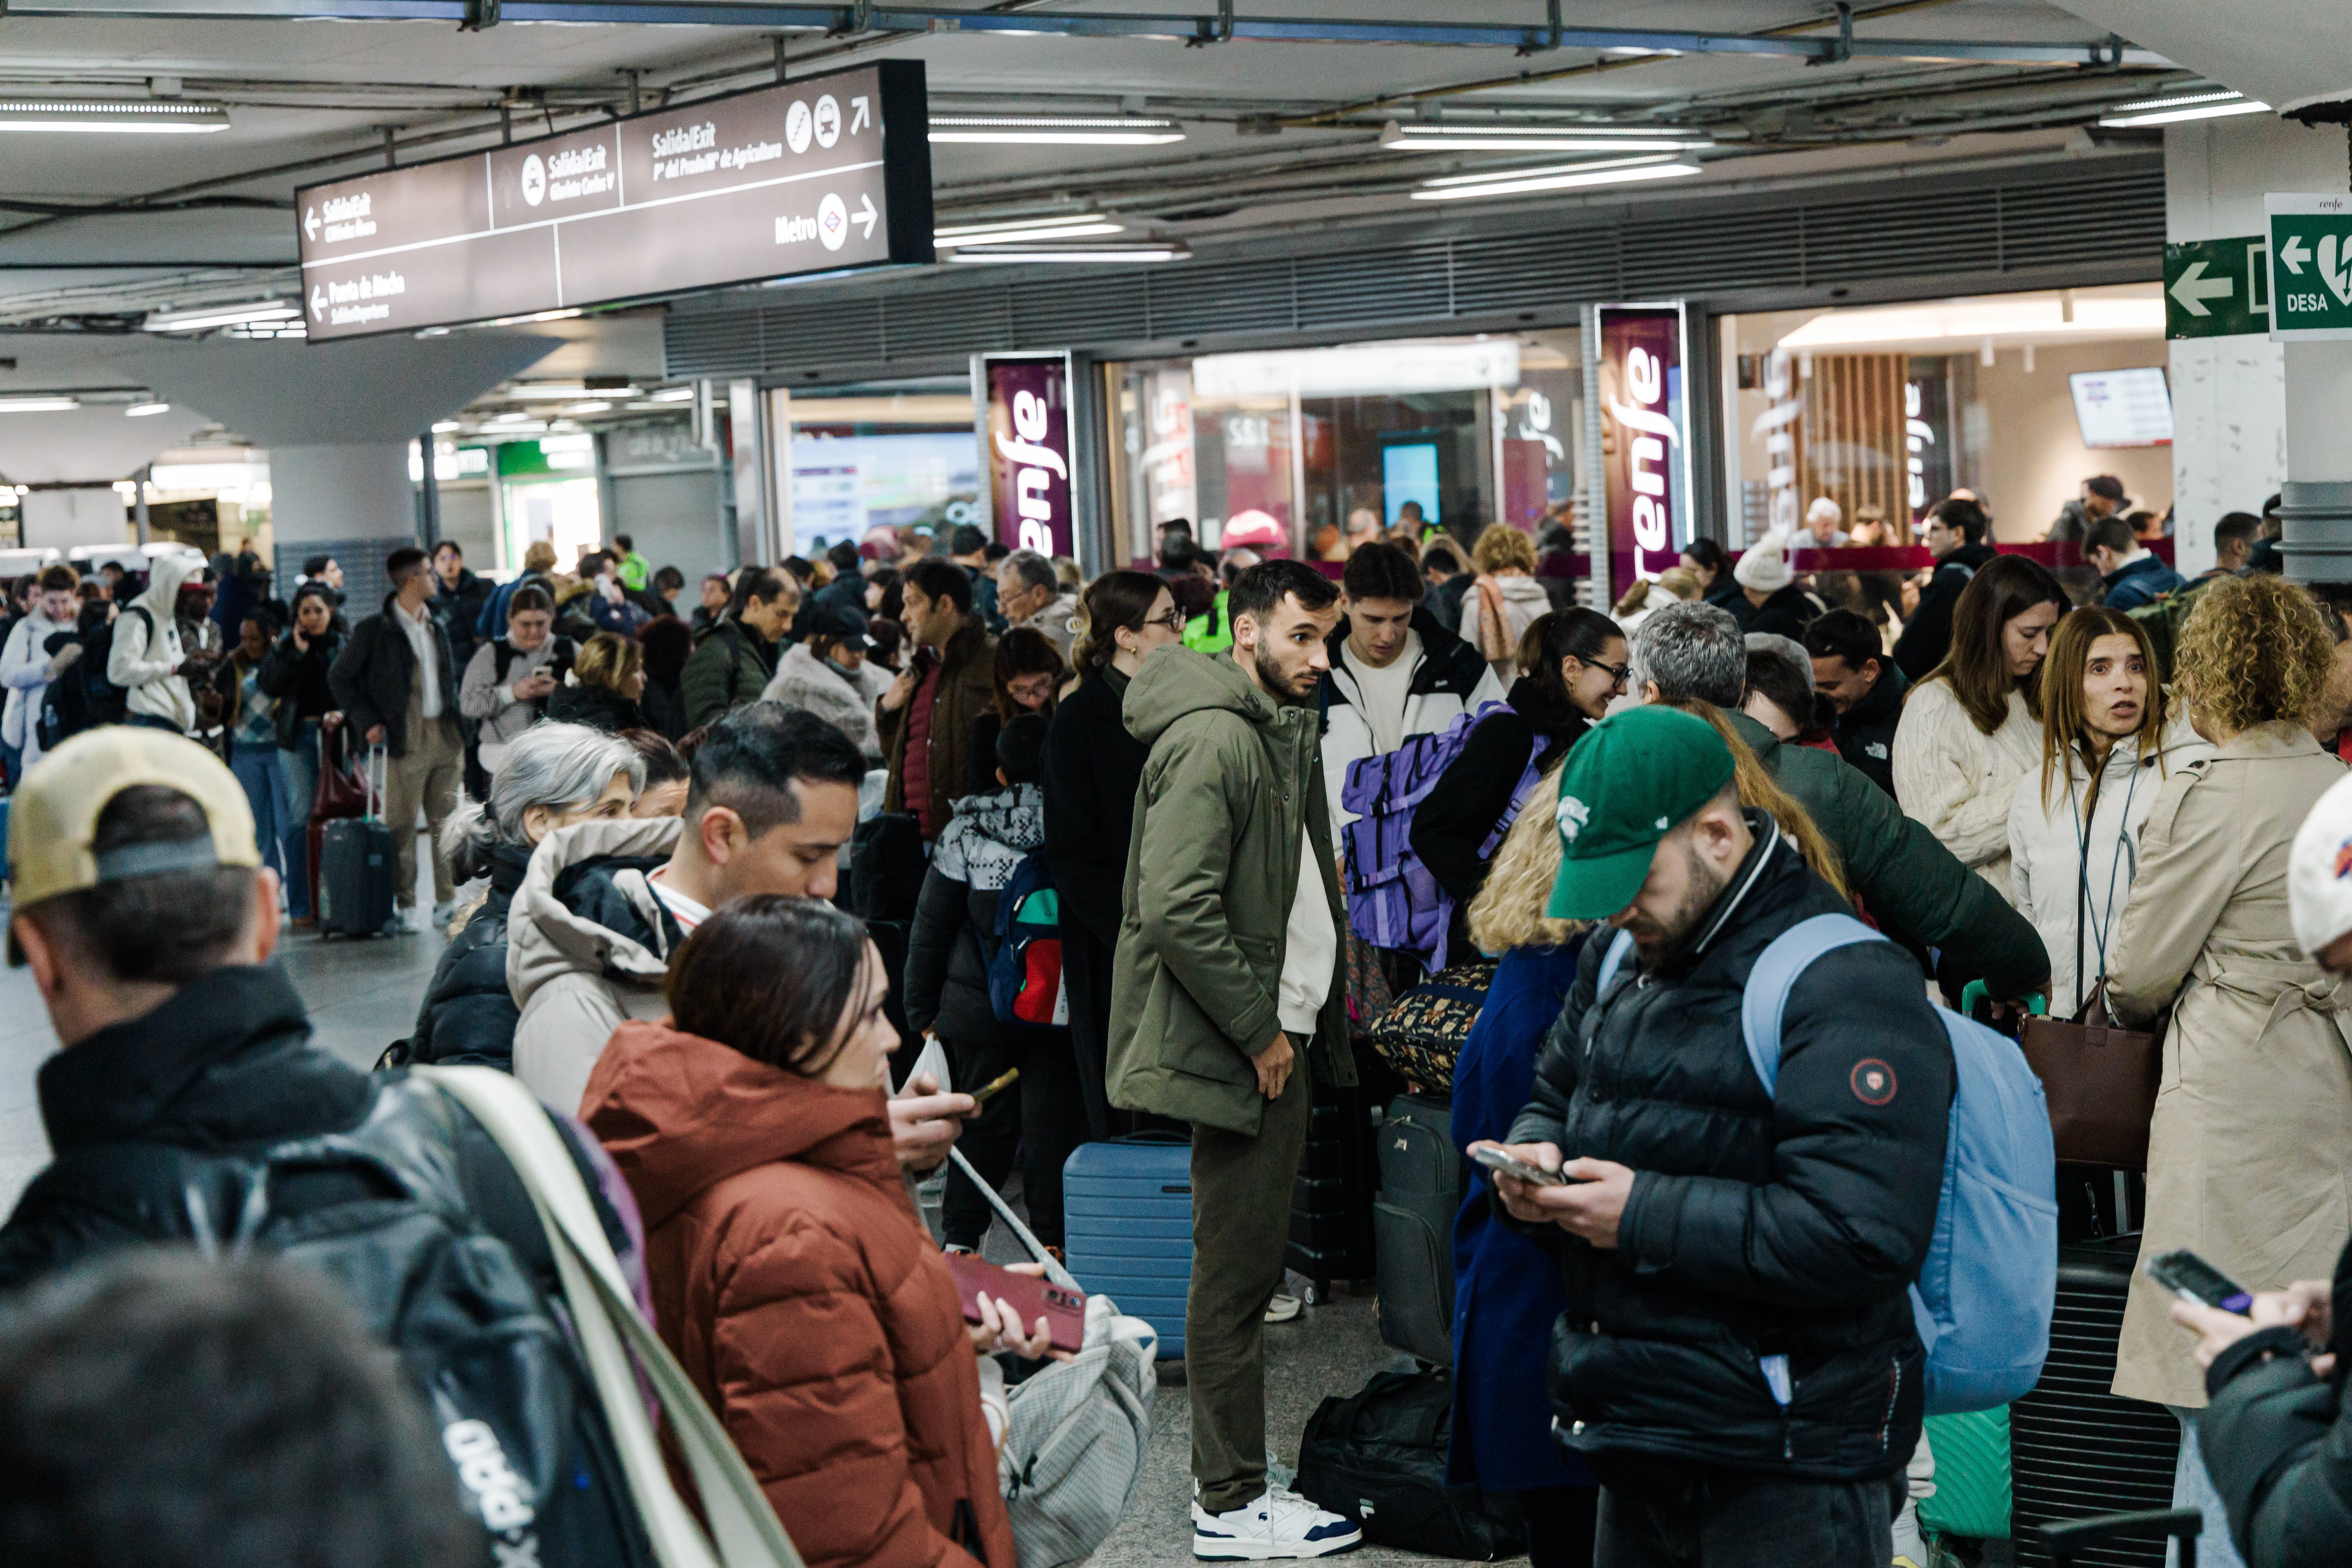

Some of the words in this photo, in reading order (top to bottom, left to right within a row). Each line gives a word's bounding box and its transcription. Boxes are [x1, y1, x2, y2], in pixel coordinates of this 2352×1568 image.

[652, 121, 716, 159] Salida/Exit
[548, 144, 606, 180] Salida/Exit
[775, 215, 818, 245] Metro
[2288, 294, 2328, 312] DESA
[995, 390, 1067, 559] enfe
